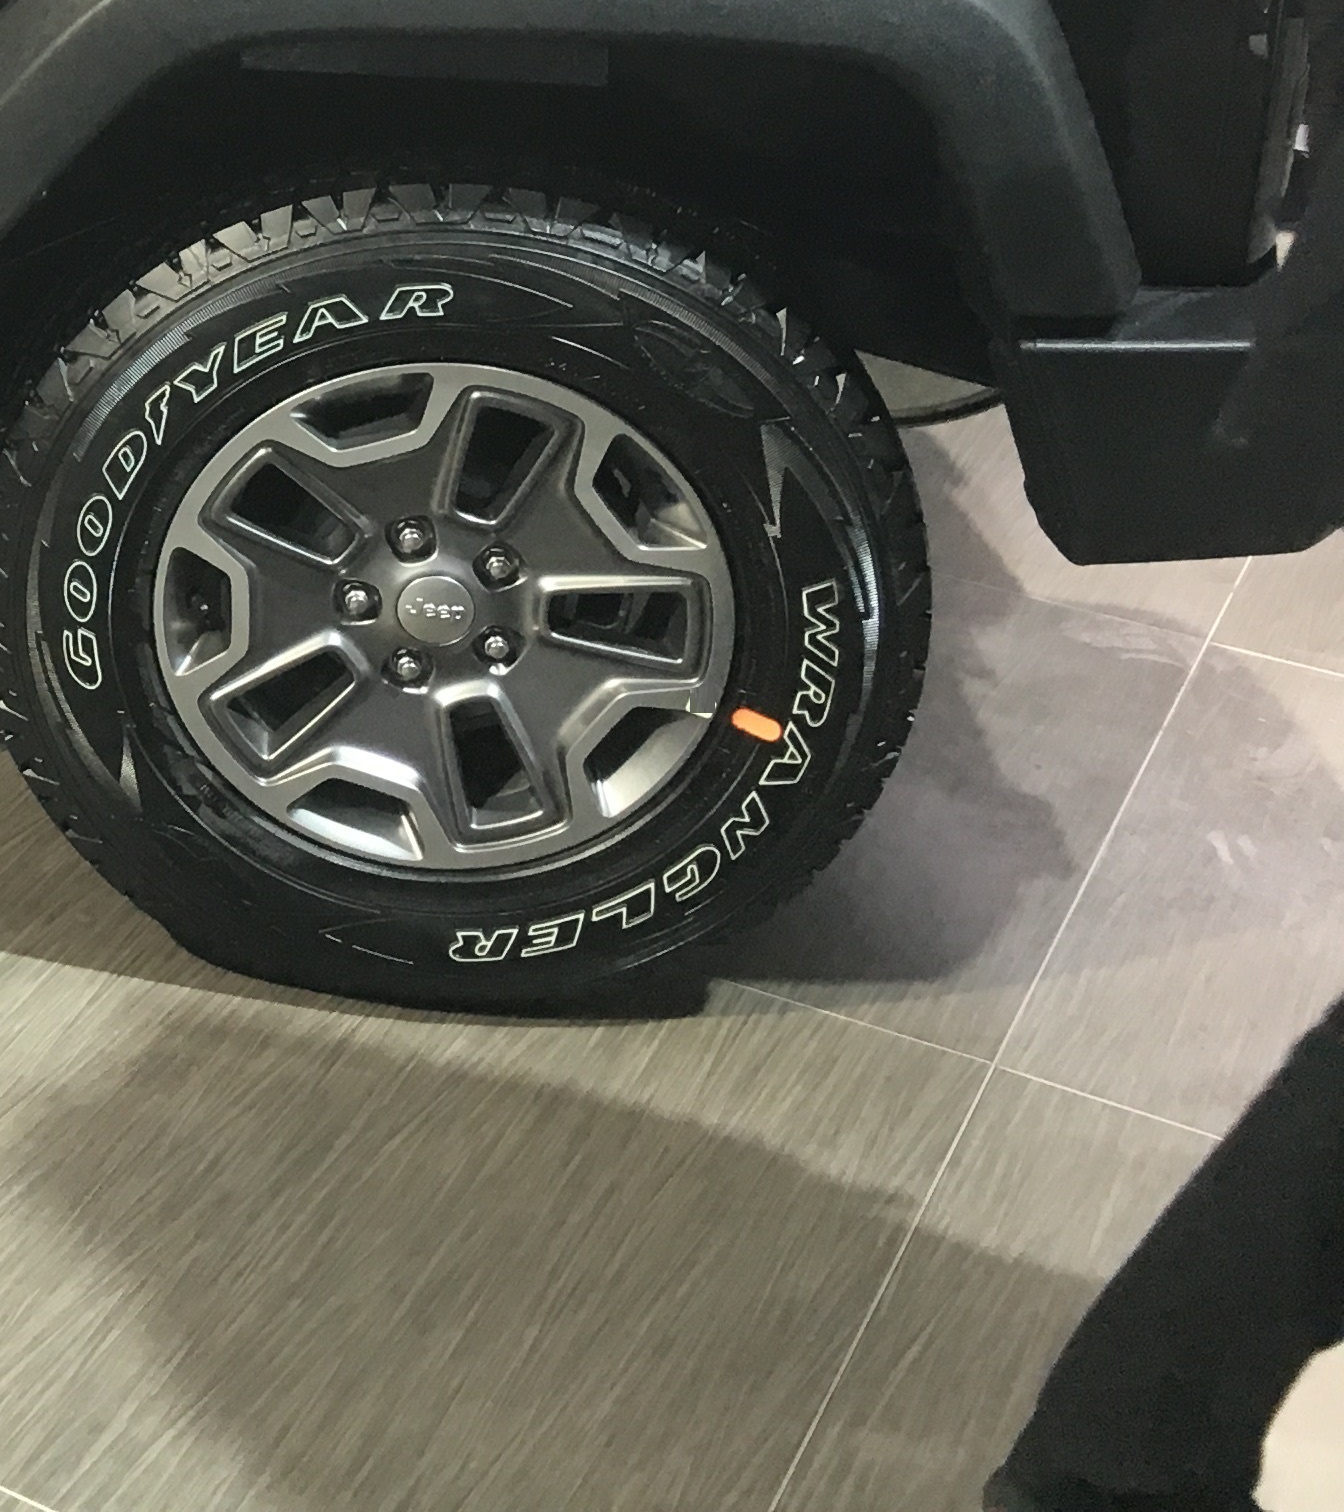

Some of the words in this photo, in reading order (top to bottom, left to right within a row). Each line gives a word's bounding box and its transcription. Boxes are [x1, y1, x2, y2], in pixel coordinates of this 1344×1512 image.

[62, 283, 456, 691] GOODYEAR
[405, 597, 466, 624] Jeep
[449, 580, 846, 966] WRANGLER
